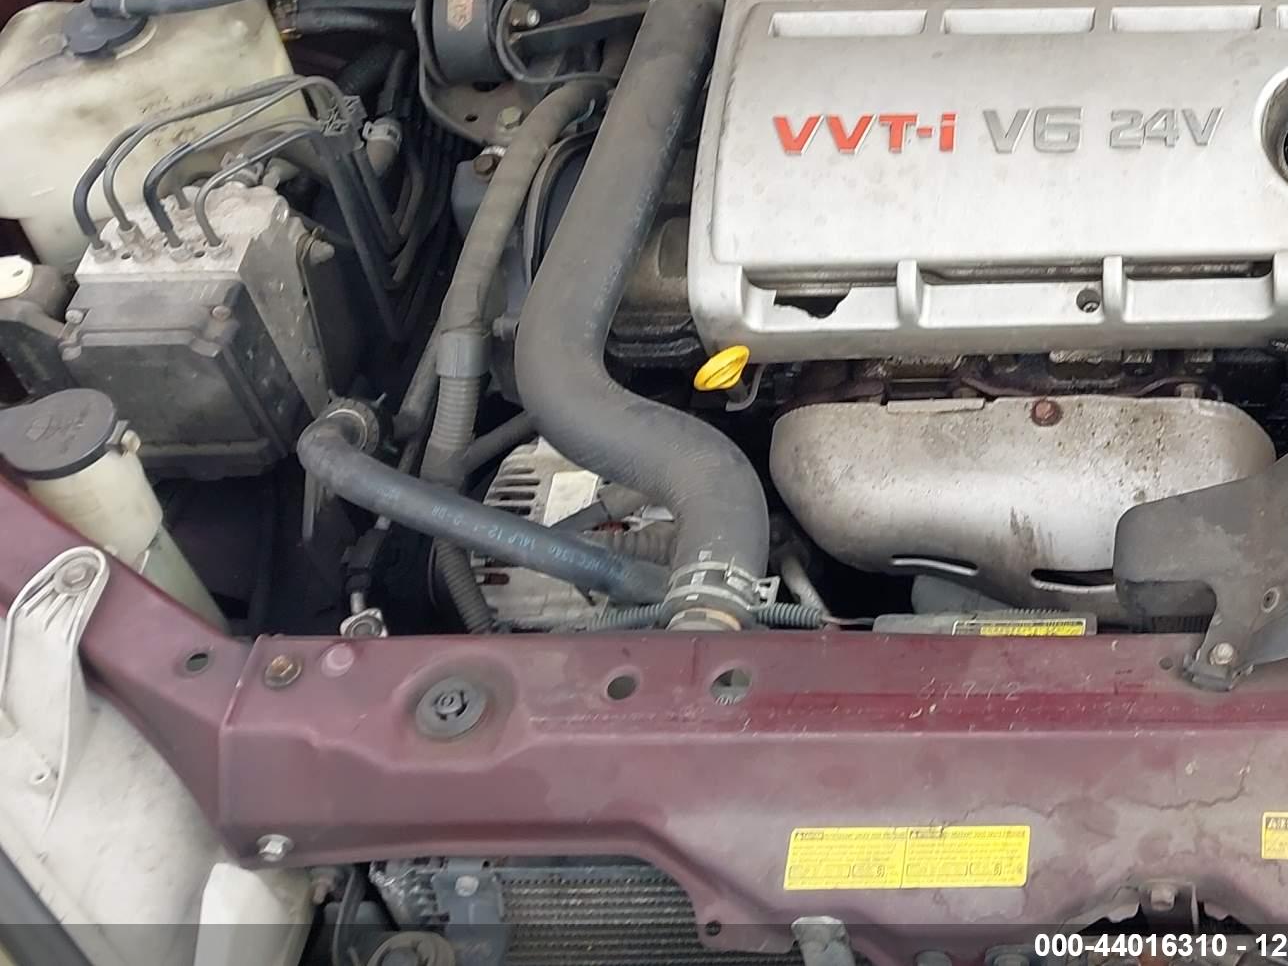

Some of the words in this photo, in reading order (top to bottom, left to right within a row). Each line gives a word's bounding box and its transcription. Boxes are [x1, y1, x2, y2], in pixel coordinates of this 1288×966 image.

[772, 113, 958, 155] VVT-i
[982, 106, 1085, 154] V6
[1108, 107, 1224, 150] 24V
